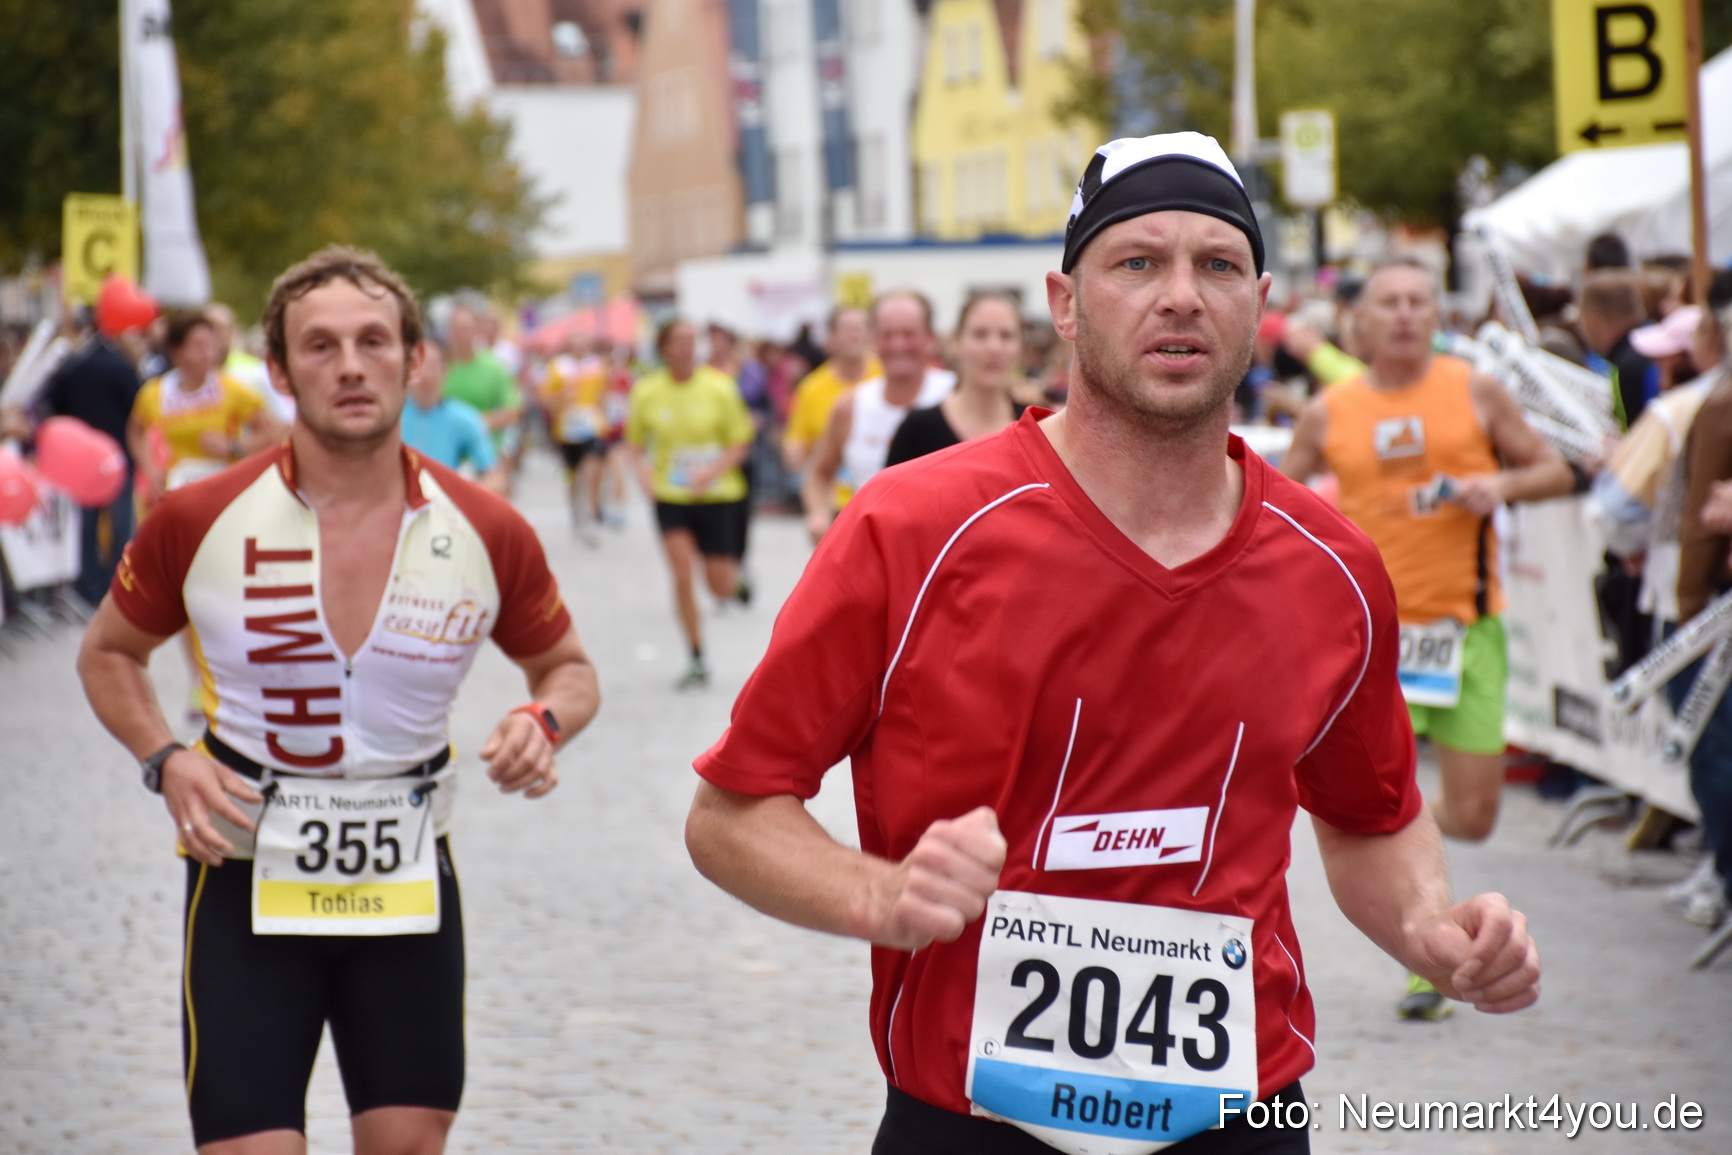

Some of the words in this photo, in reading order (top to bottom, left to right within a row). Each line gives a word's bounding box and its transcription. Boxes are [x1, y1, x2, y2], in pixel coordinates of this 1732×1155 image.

[1596, 4, 1663, 102] B
[83, 229, 117, 280] C
[387, 593, 446, 612] FITNESS
[329, 794, 404, 811] Neumarkt
[295, 818, 402, 876] 355
[1092, 826, 1166, 853] DEHN
[307, 890, 385, 914] Tobias
[989, 915, 1082, 948] PARTL
[1090, 927, 1212, 963] Neumarkt
[1004, 958, 1231, 1072] 2043
[1050, 1082, 1174, 1132] Robert
